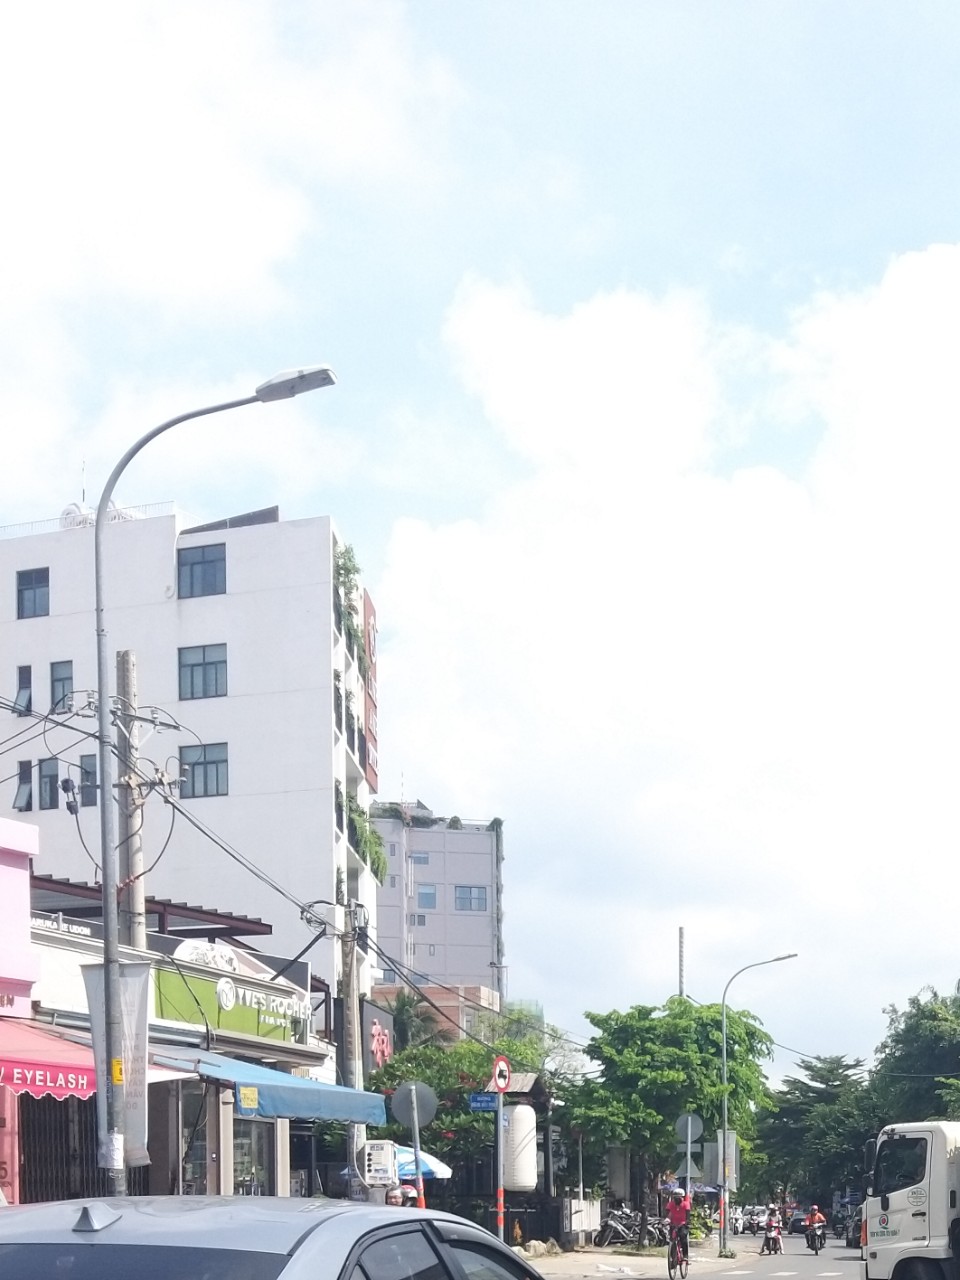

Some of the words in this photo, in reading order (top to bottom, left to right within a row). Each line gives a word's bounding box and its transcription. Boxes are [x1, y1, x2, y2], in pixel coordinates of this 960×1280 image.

[31, 917, 68, 932] ARUKAE
[69, 924, 91, 936] UDON
[237, 987, 267, 1011] YVES
[270, 995, 312, 1021] ROCHER
[13, 1068, 88, 1090] EYELASH
